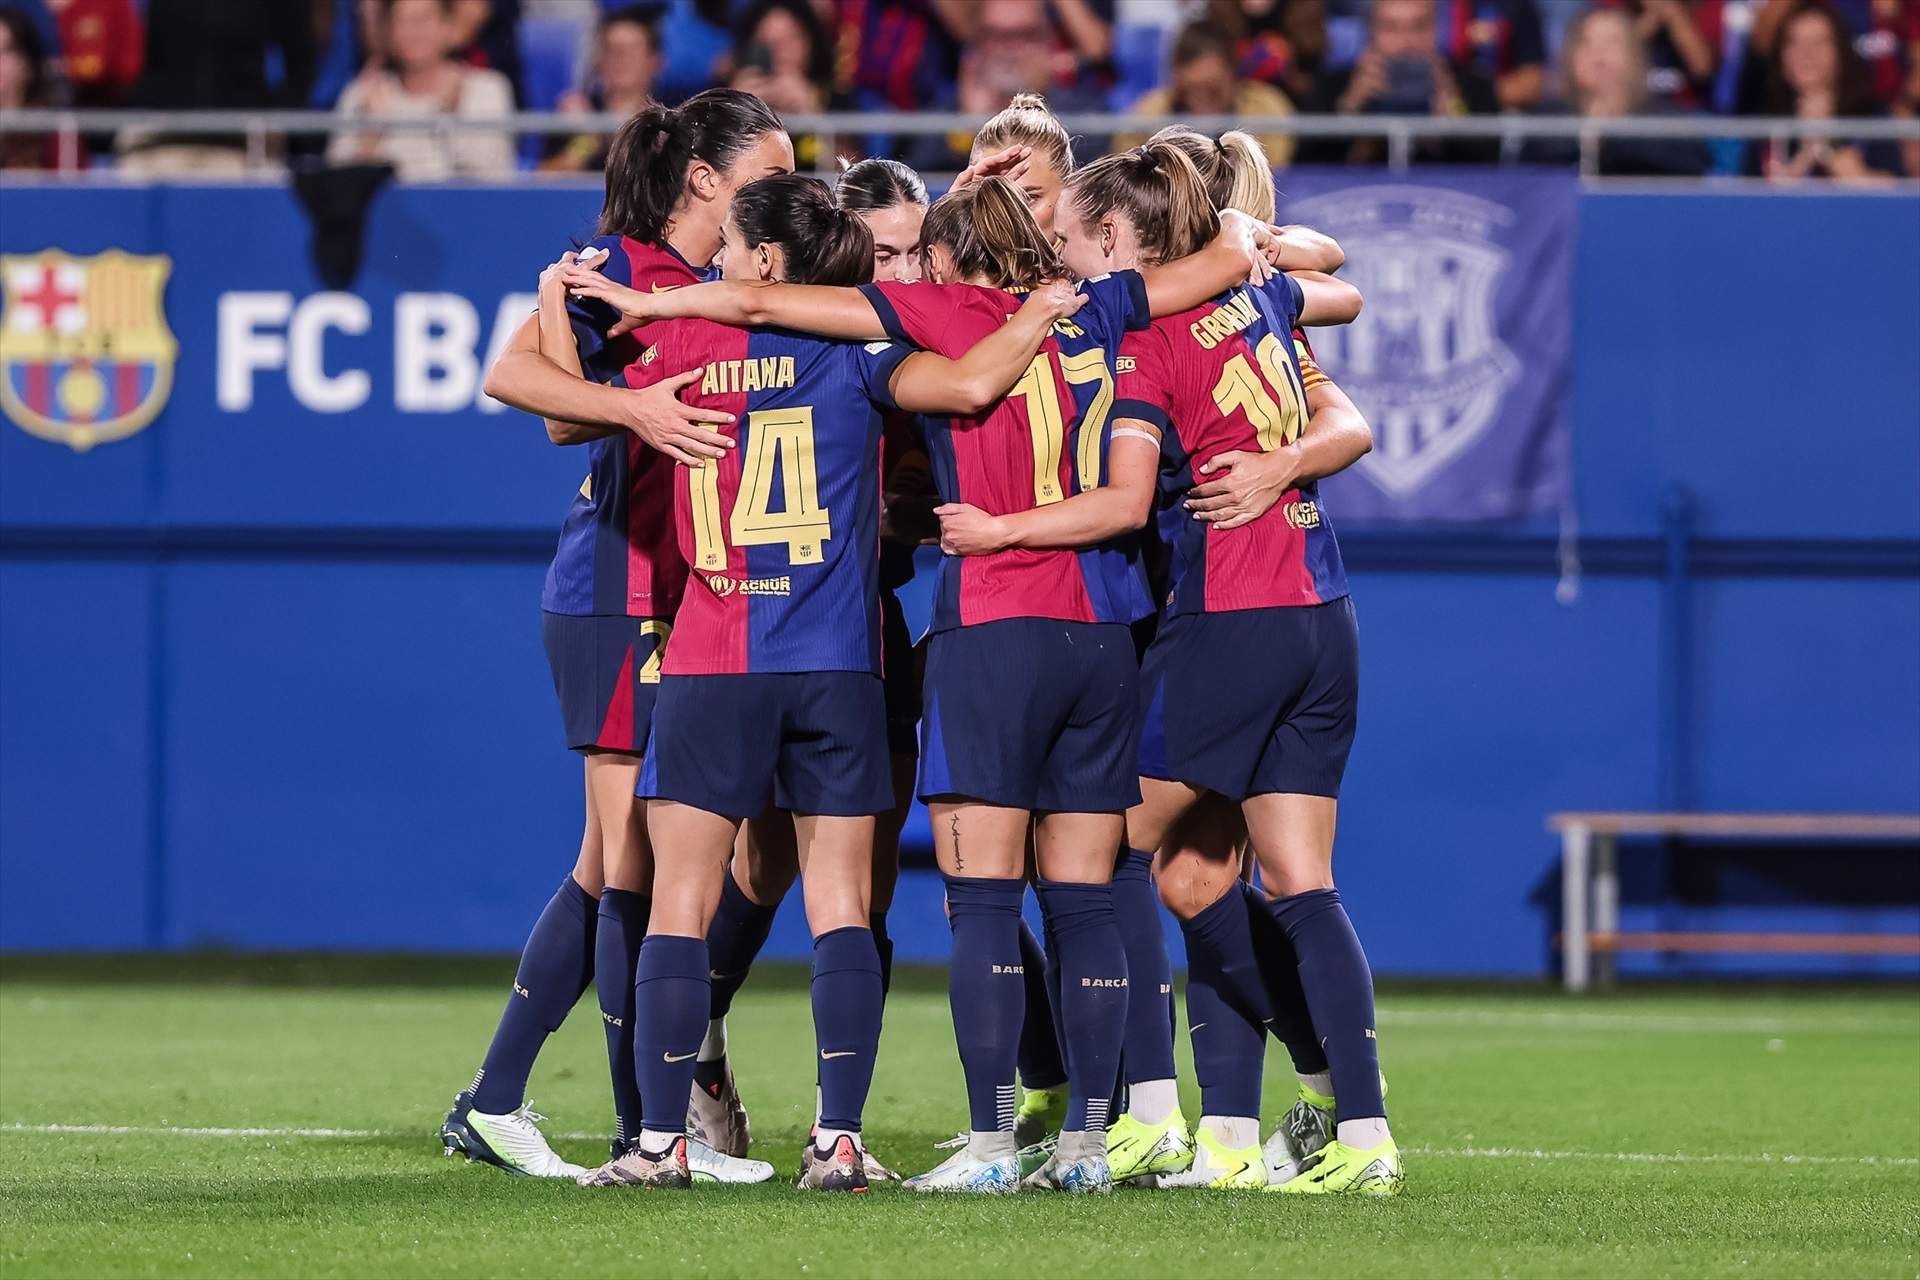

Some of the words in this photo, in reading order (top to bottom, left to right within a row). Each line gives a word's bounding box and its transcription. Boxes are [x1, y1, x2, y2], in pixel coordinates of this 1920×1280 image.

[217, 290, 372, 414] FC
[701, 356, 795, 396] AITANA
[1211, 332, 1311, 452] 10
[1007, 347, 1115, 507] 17
[688, 405, 832, 572] 14
[738, 579, 791, 591] ACNUR
